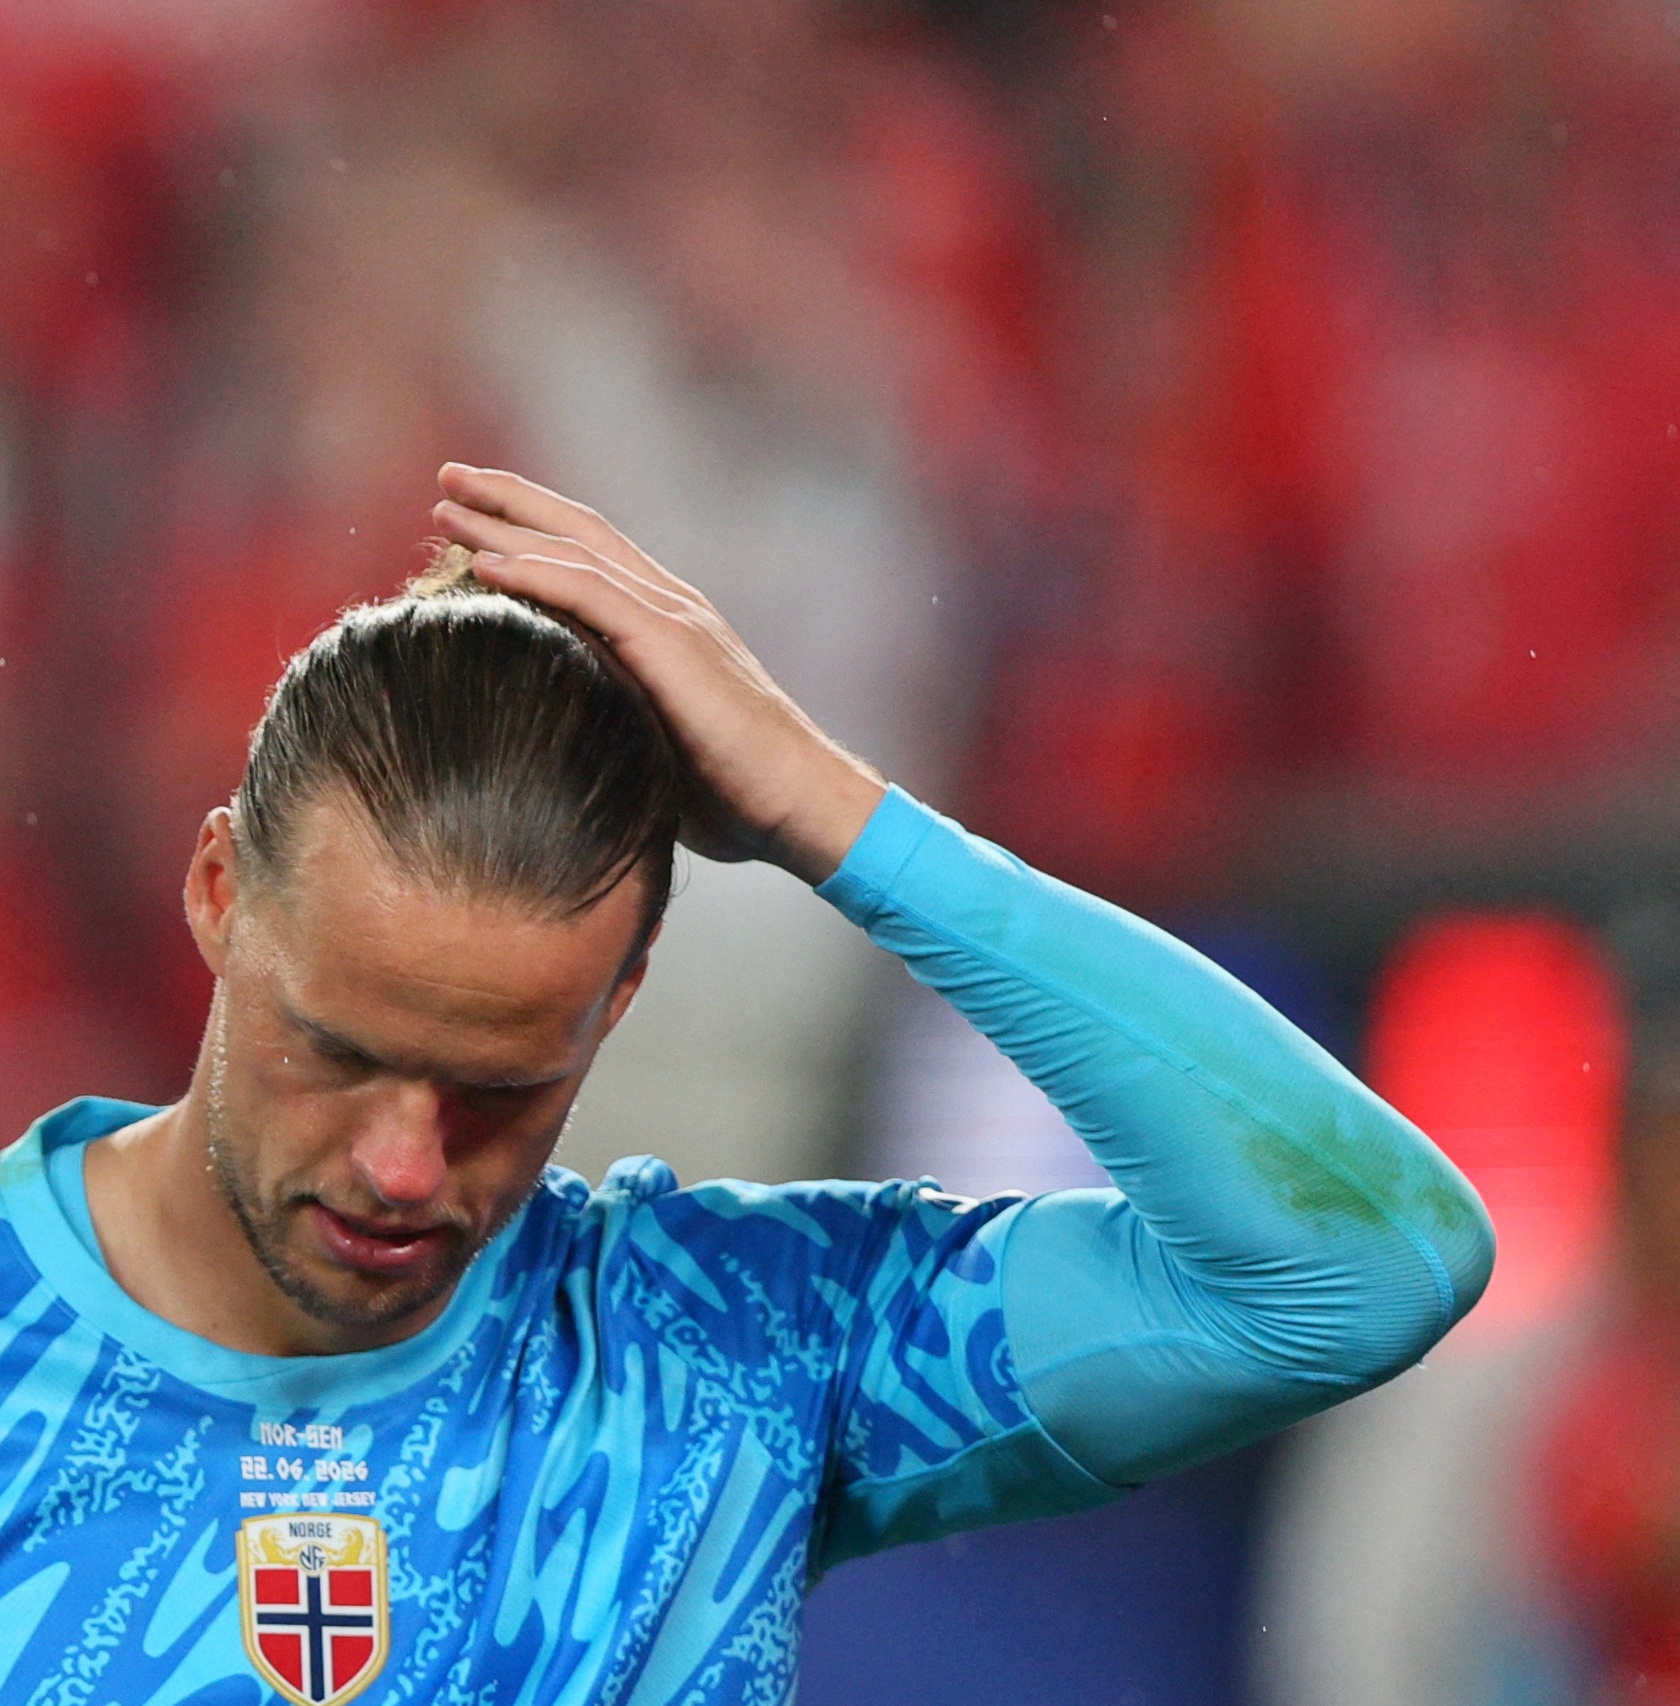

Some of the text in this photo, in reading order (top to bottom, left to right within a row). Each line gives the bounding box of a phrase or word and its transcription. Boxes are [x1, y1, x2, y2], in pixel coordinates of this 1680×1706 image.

[259, 1422, 343, 1449] NOR-SEN
[240, 1491, 376, 1508] NEW YORK NEW JERSEY
[289, 1521, 332, 1538] NORGE
